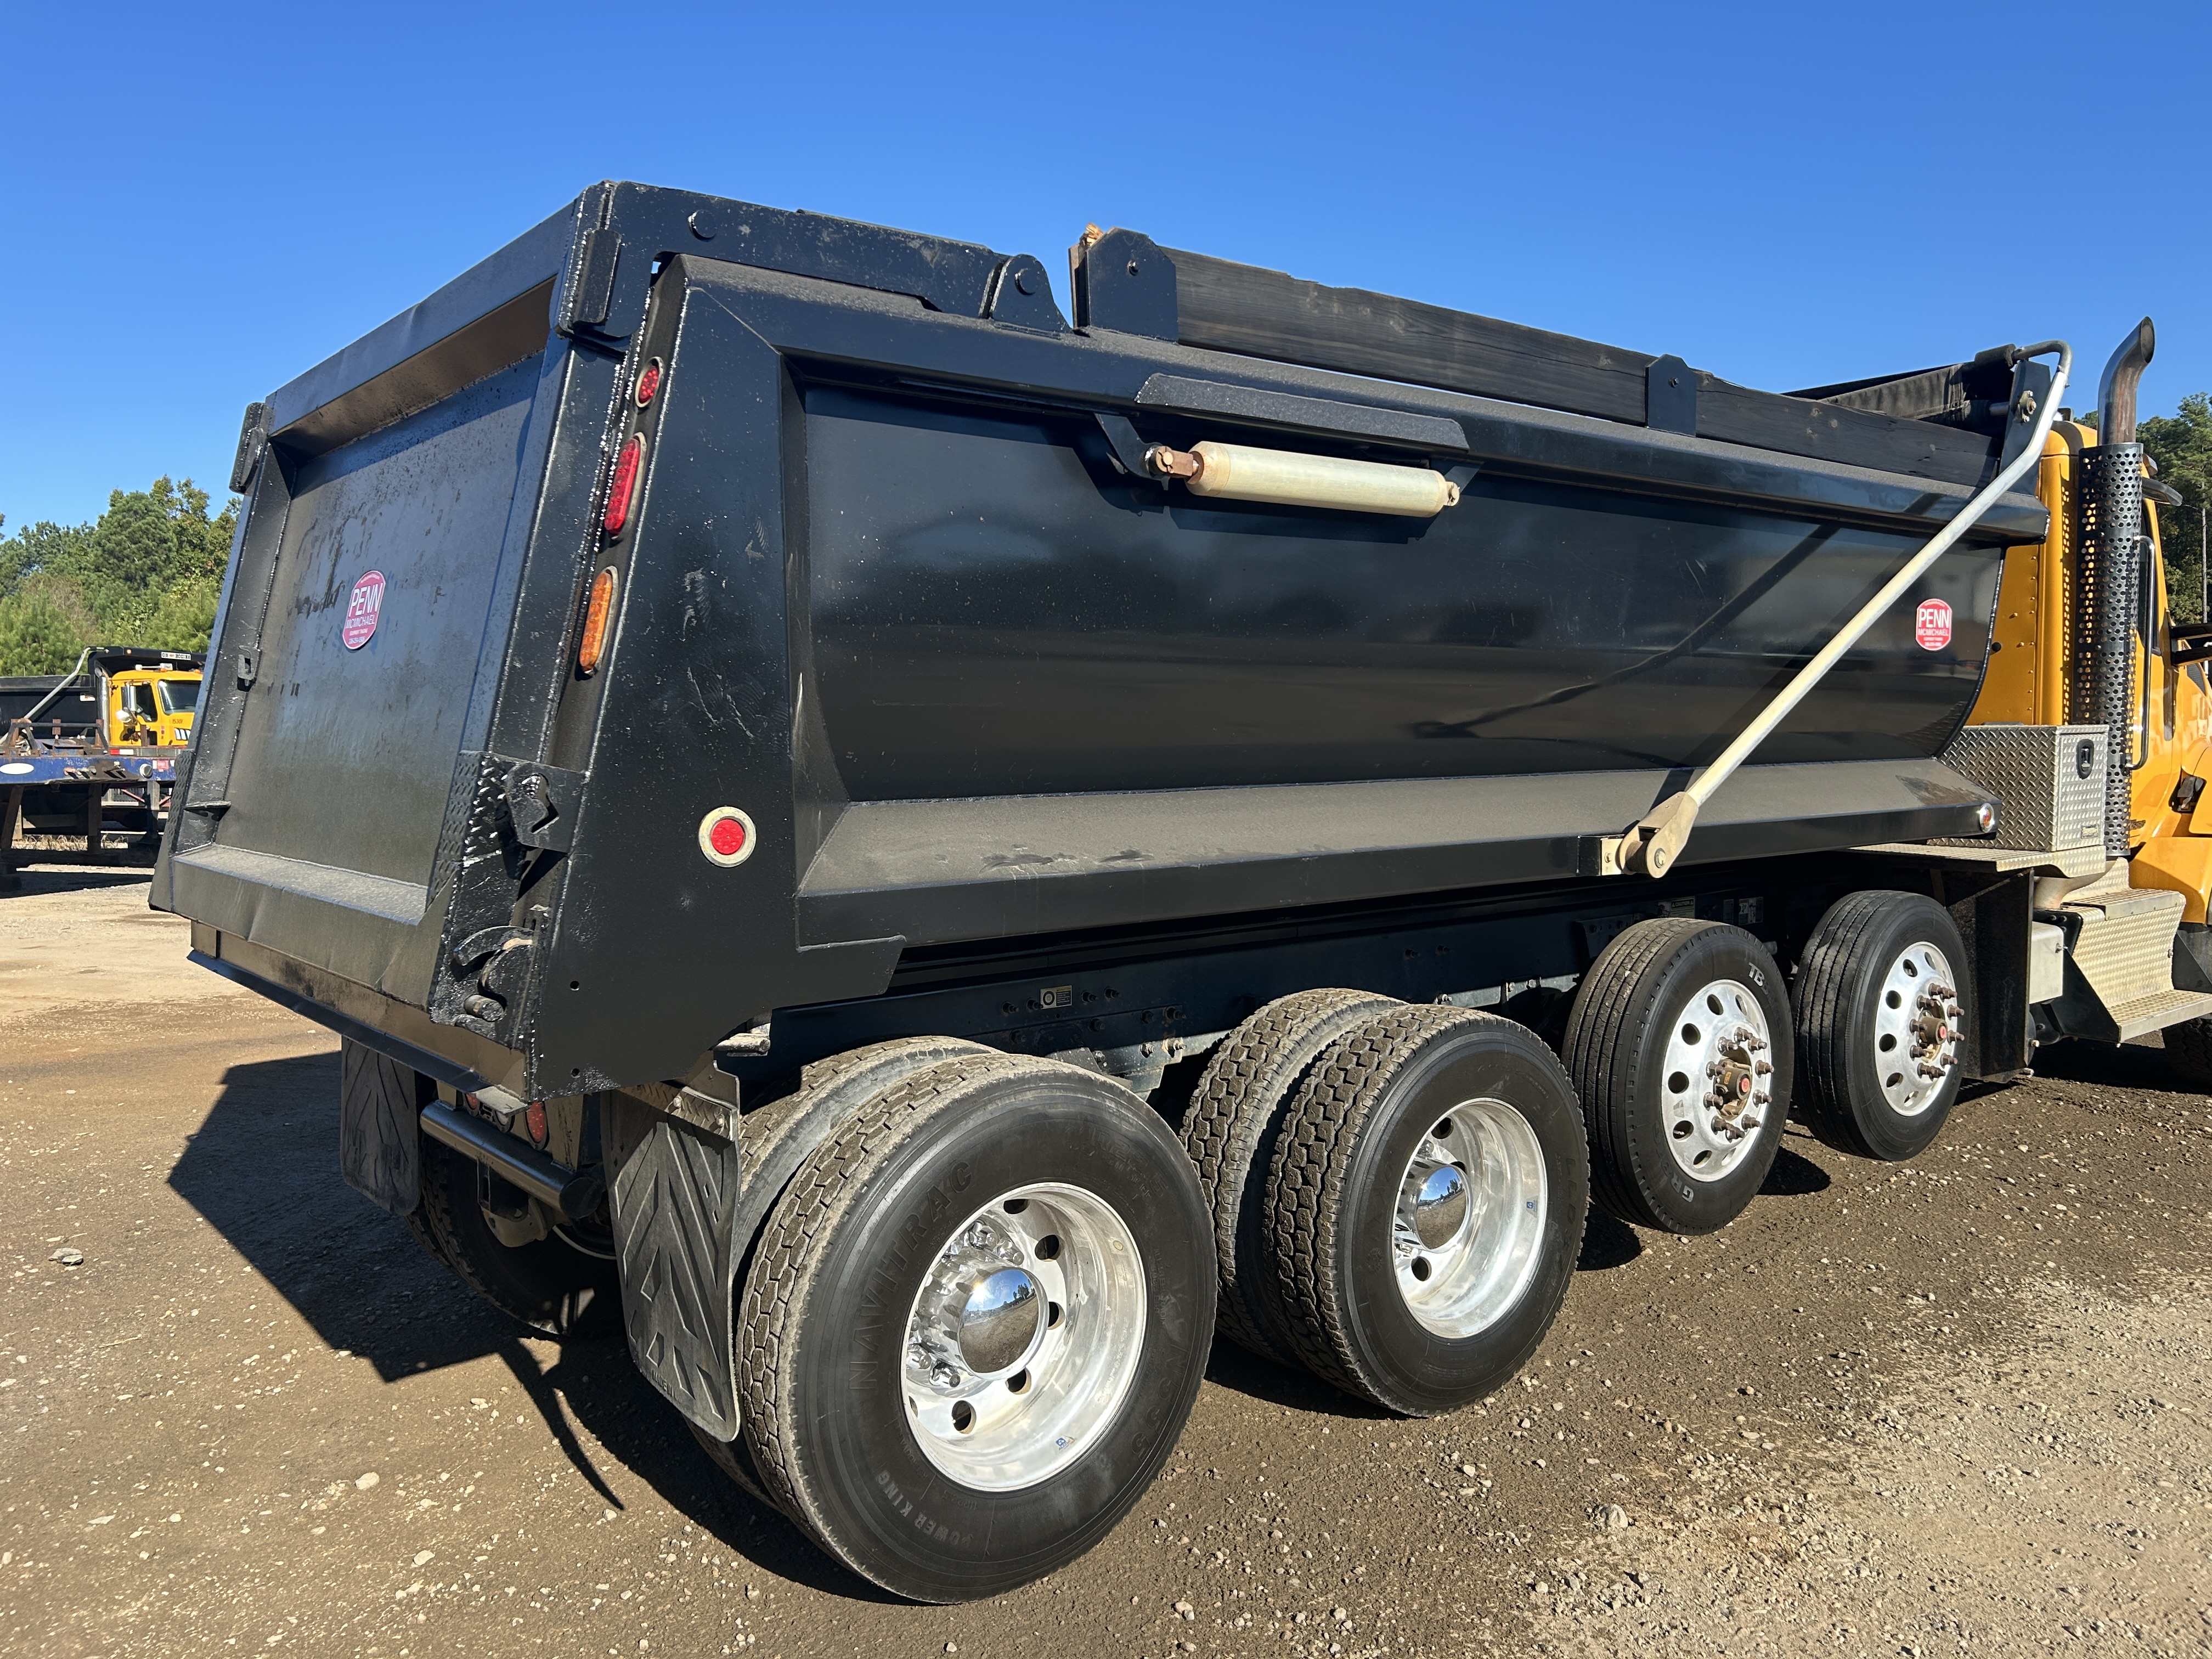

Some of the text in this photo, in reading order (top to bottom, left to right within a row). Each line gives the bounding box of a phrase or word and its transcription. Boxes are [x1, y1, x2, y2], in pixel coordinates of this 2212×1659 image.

[348, 582, 383, 617] PENN
[1918, 608, 1949, 628] PENN
[848, 1161, 973, 1390] NAVITRAC
[877, 1469, 974, 1548] POWER KING
